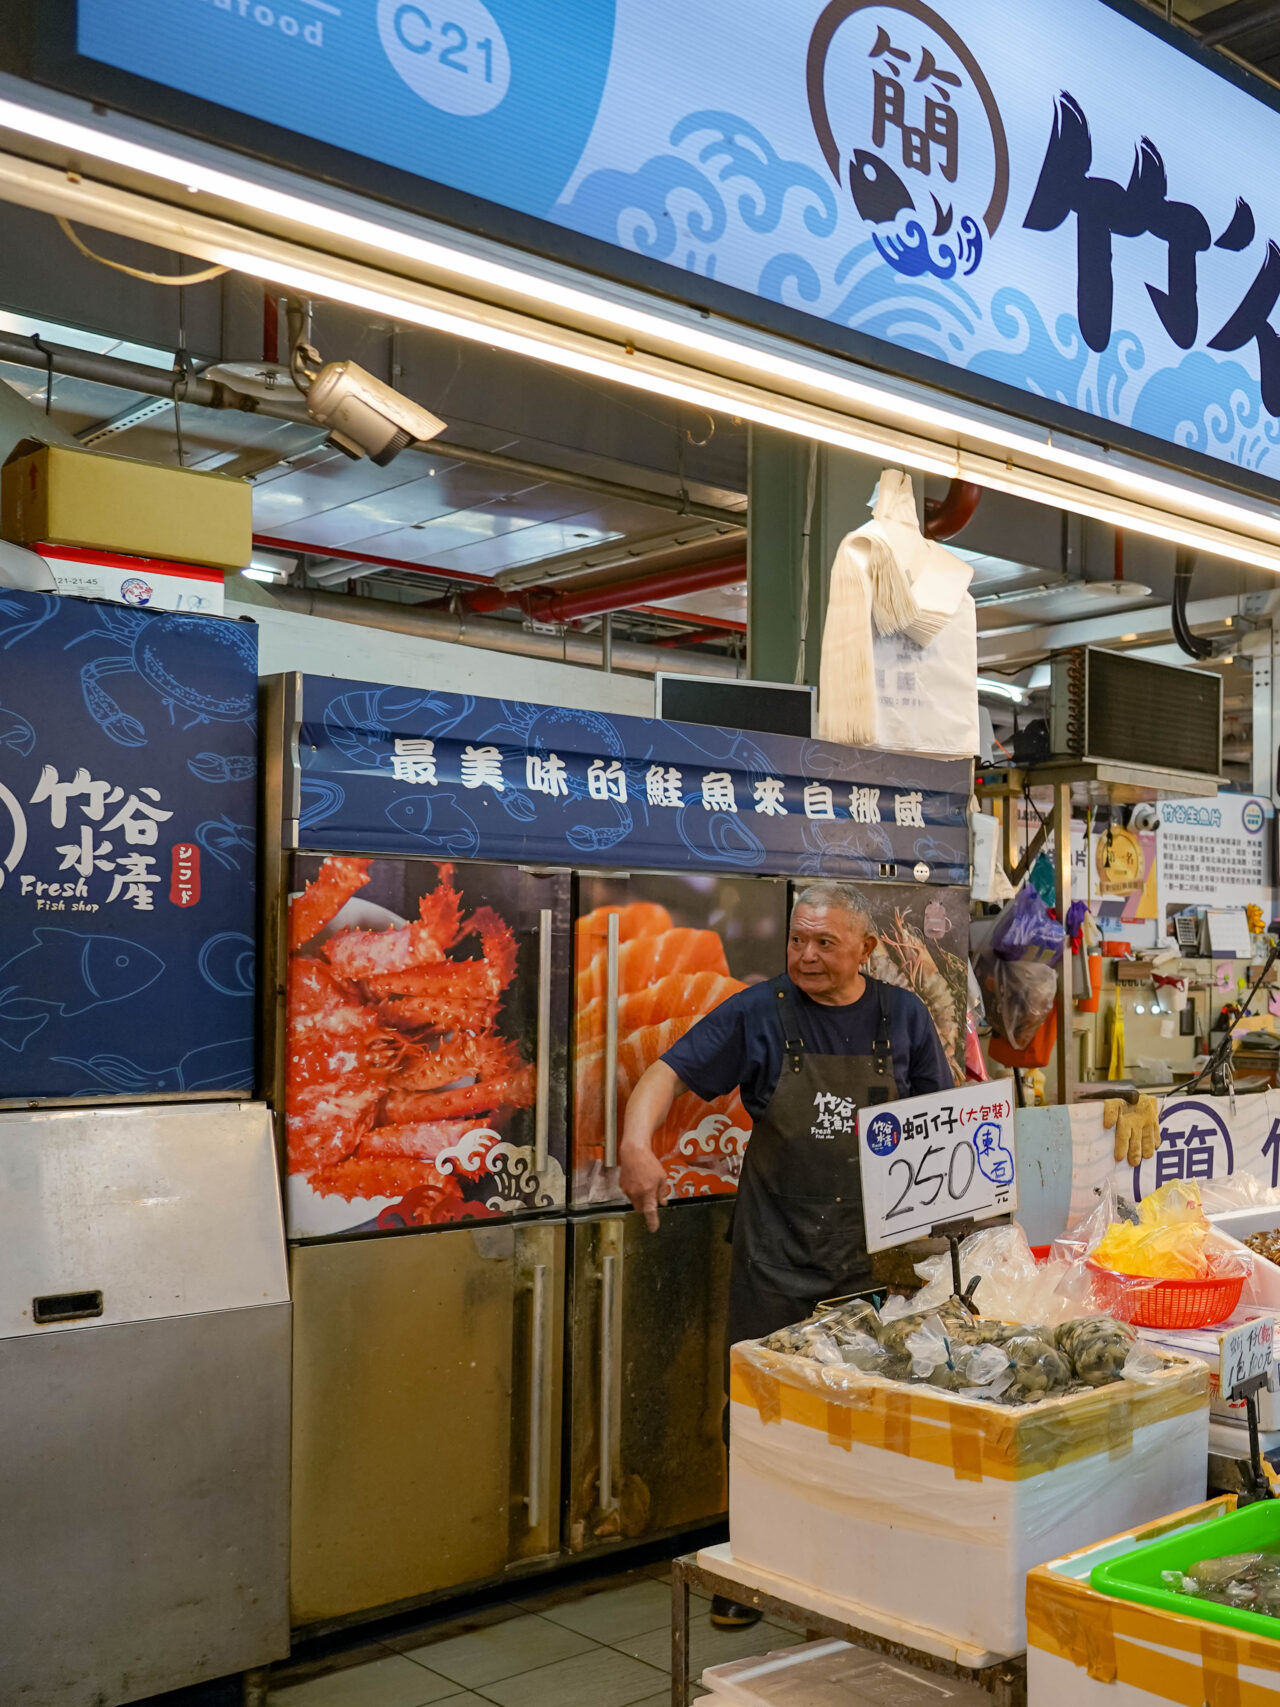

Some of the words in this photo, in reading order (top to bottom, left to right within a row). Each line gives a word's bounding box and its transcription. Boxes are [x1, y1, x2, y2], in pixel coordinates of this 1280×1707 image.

[393, 5, 493, 83] C21
[867, 24, 963, 183] 簡
[390, 738, 927, 829] 最美味的鮭魚來自挪威
[29, 764, 174, 846] 竹谷
[20, 875, 89, 898] Fresh
[55, 825, 162, 911] 水產
[37, 899, 66, 911] Fish
[71, 900, 100, 913] shop
[813, 1091, 857, 1118] 竹谷
[816, 1112, 856, 1134] 生魚片
[902, 1106, 958, 1141] 蚵仔
[810, 1126, 832, 1135] Fresh
[872, 1120, 893, 1134] 竹谷
[980, 1129, 1008, 1179] 東石
[1155, 1124, 1218, 1188] 簡
[881, 1141, 975, 1220] 250
[995, 1184, 1010, 1204] 元
